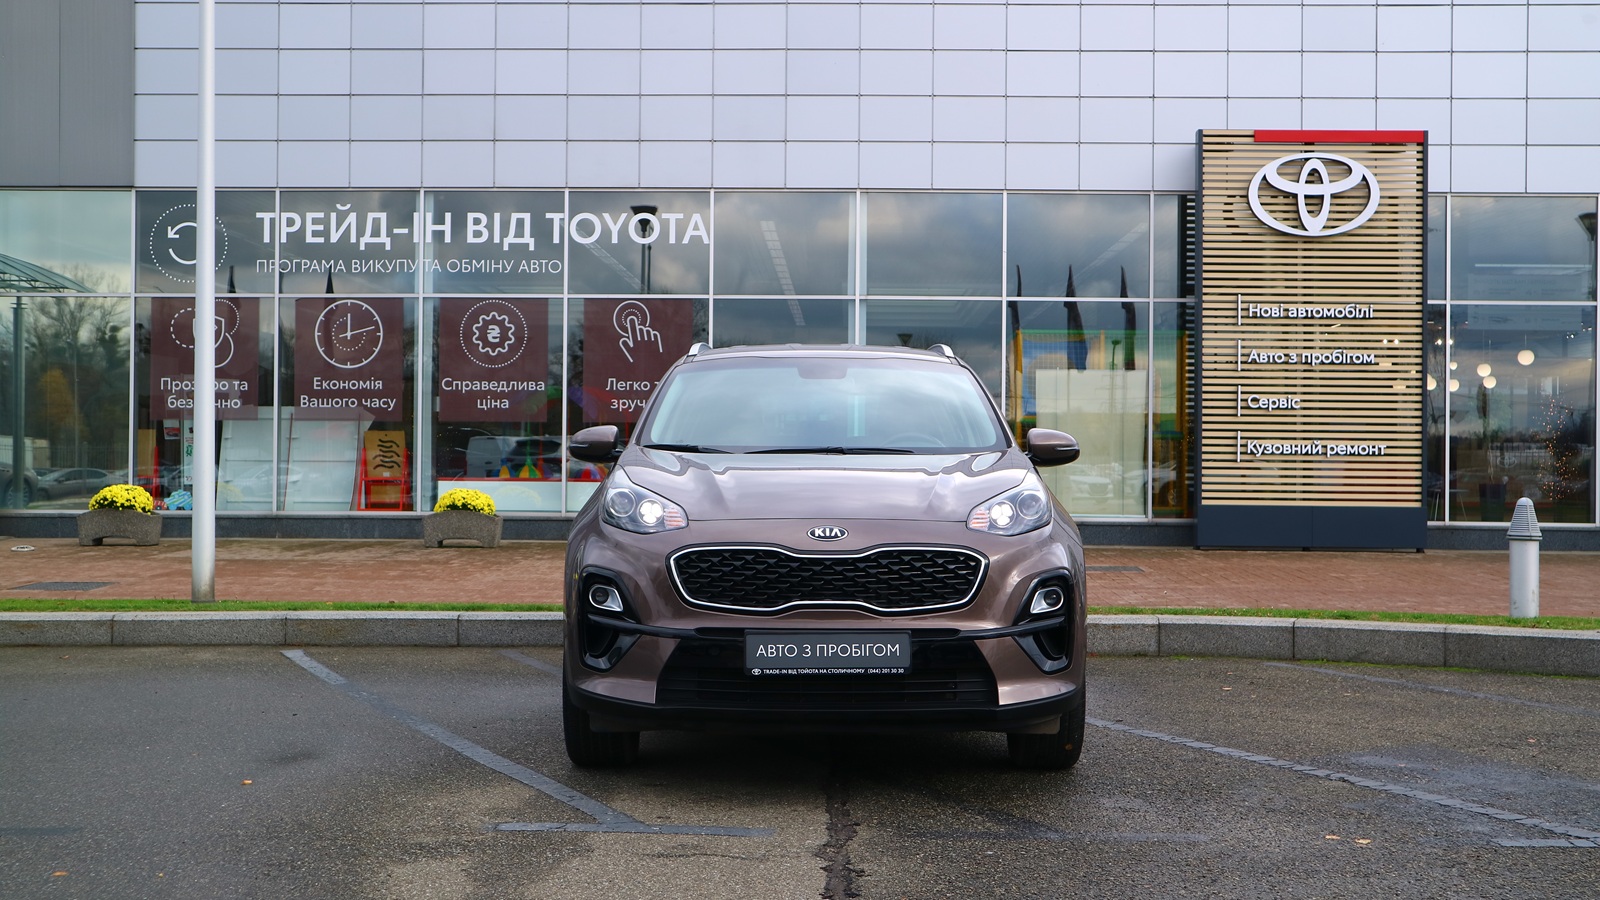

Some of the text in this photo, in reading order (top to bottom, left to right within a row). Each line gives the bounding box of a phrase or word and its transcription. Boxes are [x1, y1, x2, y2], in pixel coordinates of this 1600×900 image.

[256, 203, 710, 251] ТРЕЙД-ІН ВІД TOYOTA
[256, 258, 562, 273] ПРОГРАМА ВИКУПУ ТА ОБМІНУ АВТО
[1249, 303, 1374, 318] Нові автомобілі
[1248, 349, 1375, 366] Авто з пробігом
[160, 377, 248, 391] Проо та
[313, 376, 383, 390] Економія
[441, 377, 545, 394] Справедлива
[606, 378, 650, 391] Легко
[167, 394, 241, 409] безчно
[300, 395, 396, 411] Вашого часу
[477, 395, 509, 412] ціна
[610, 399, 646, 412] зруч
[1247, 395, 1301, 411] Сервіс
[1247, 440, 1387, 458] Кузовний ремонт
[814, 528, 842, 537] KIA
[756, 644, 798, 657] АВТО
[816, 643, 900, 657] ПРОБІГОМ
